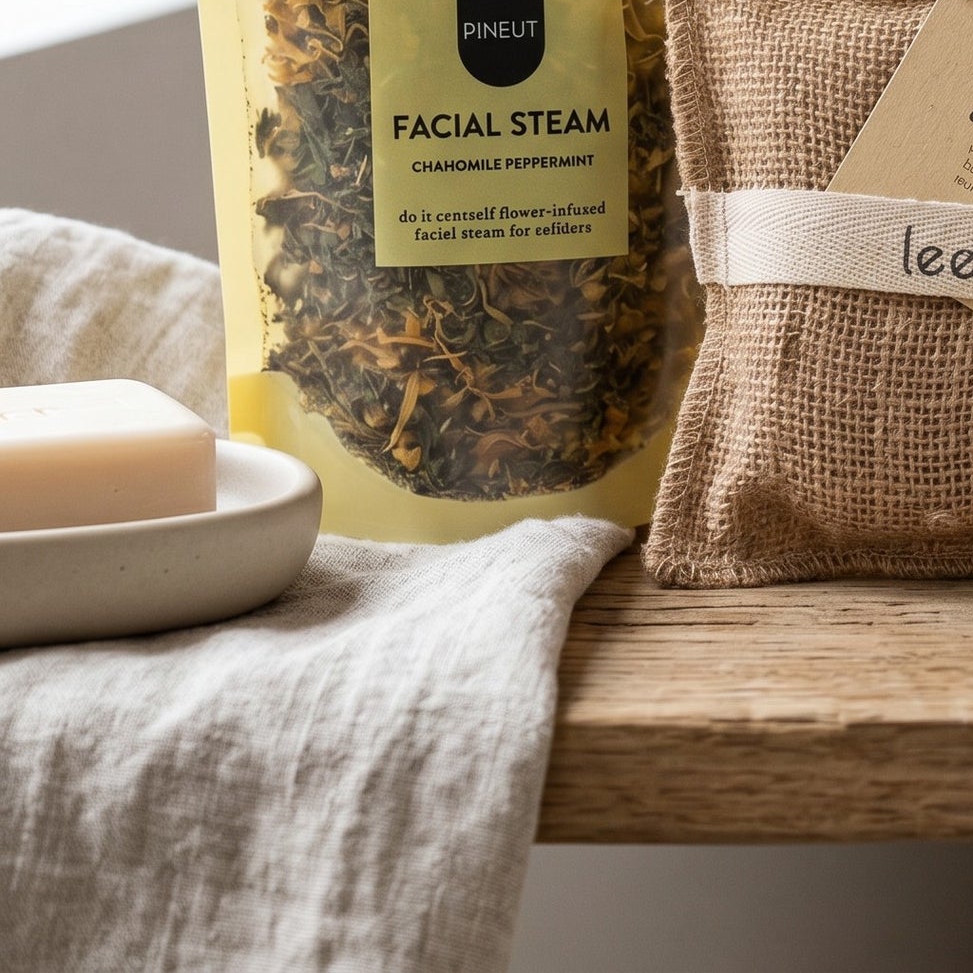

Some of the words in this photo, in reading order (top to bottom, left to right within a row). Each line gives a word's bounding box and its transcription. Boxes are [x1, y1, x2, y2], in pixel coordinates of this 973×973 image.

[463, 20, 538, 40] PINEUT
[393, 112, 501, 140] FACIAL
[510, 108, 611, 136] STEAM
[505, 154, 594, 170] PEPPERMINT
[399, 210, 417, 223] do
[421, 209, 432, 222] it
[461, 227, 505, 239] steam
[509, 224, 531, 237] for
